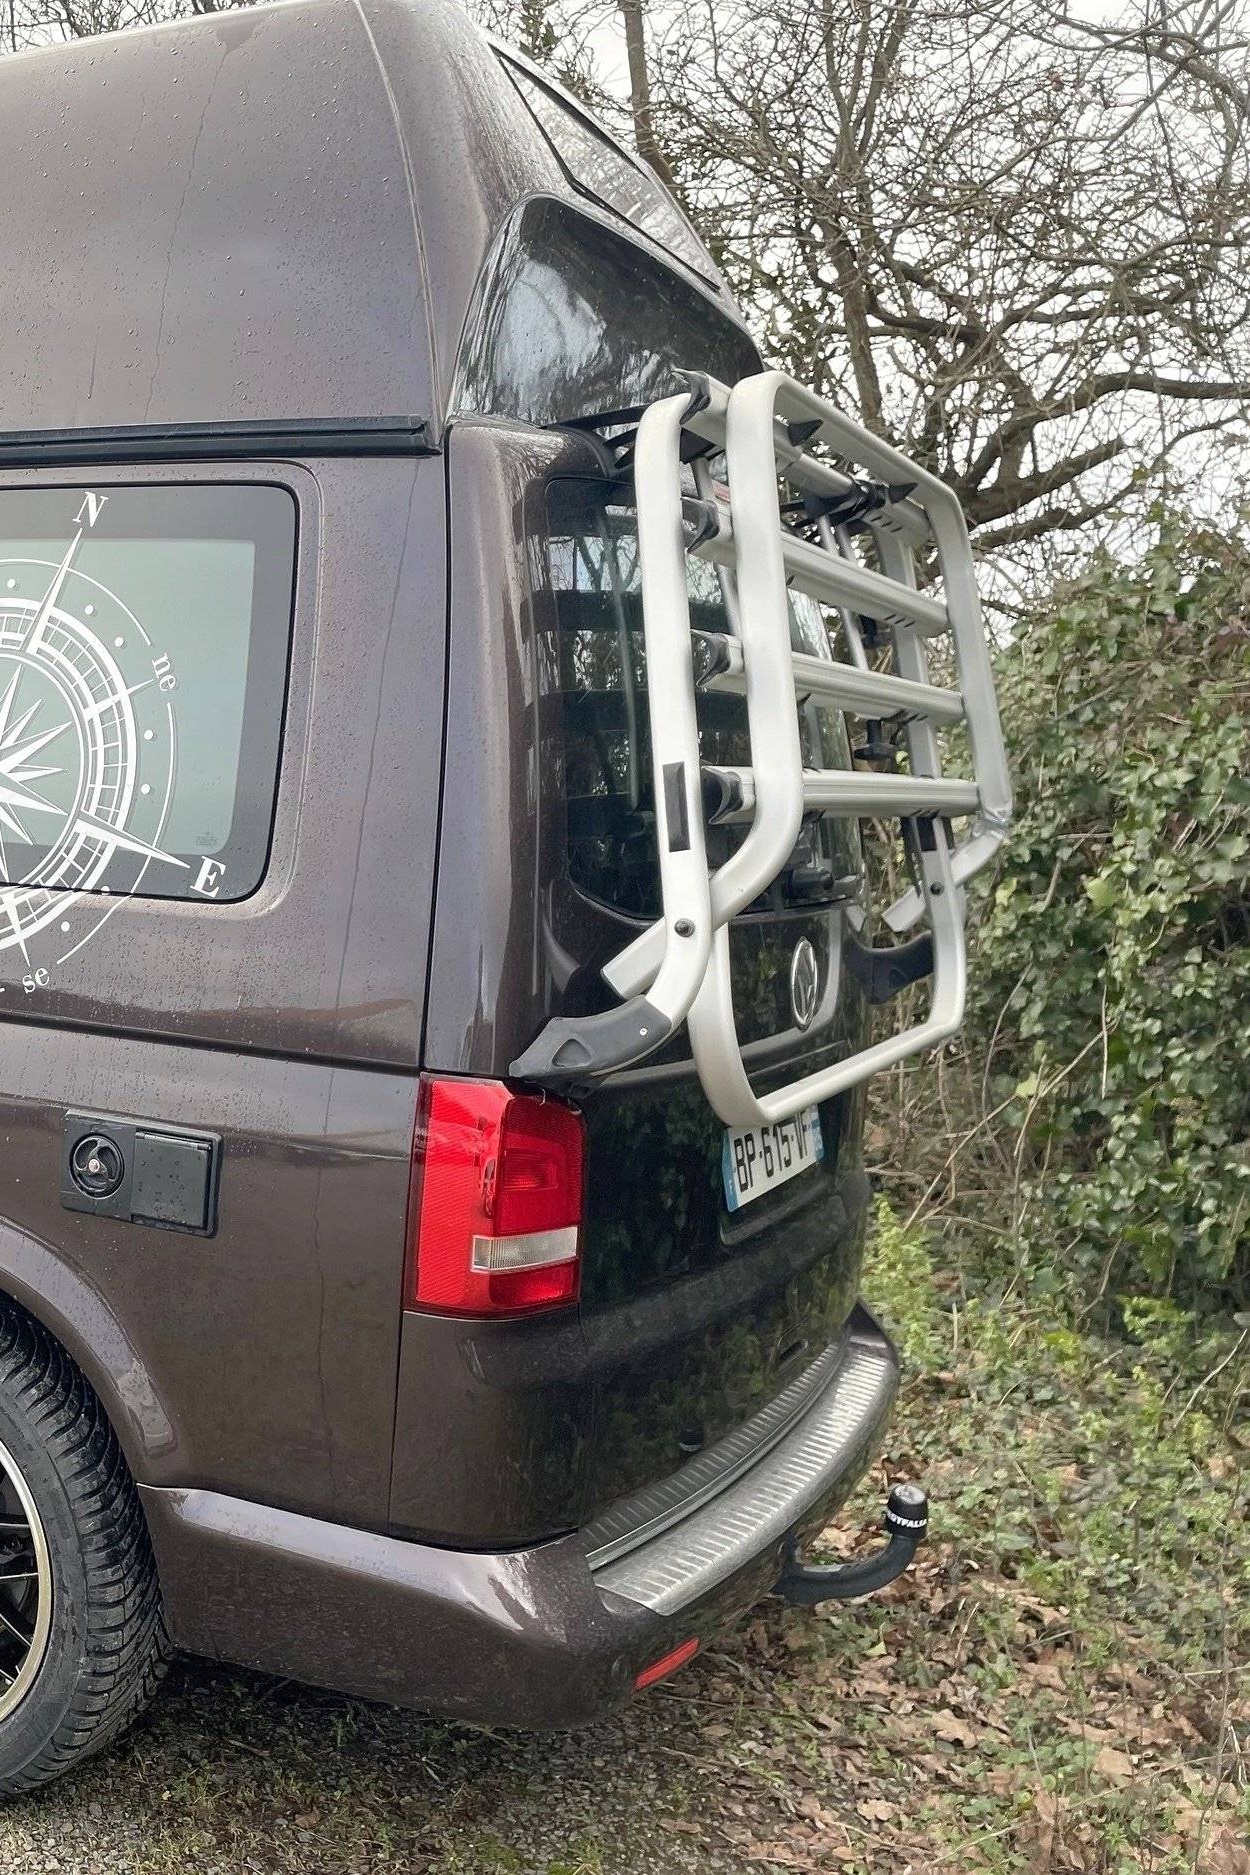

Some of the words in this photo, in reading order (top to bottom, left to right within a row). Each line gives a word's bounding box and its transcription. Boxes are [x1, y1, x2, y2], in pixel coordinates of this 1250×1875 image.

[72, 491, 110, 527] N
[151, 652, 176, 691] ne
[190, 855, 227, 898] E
[22, 967, 50, 994] se
